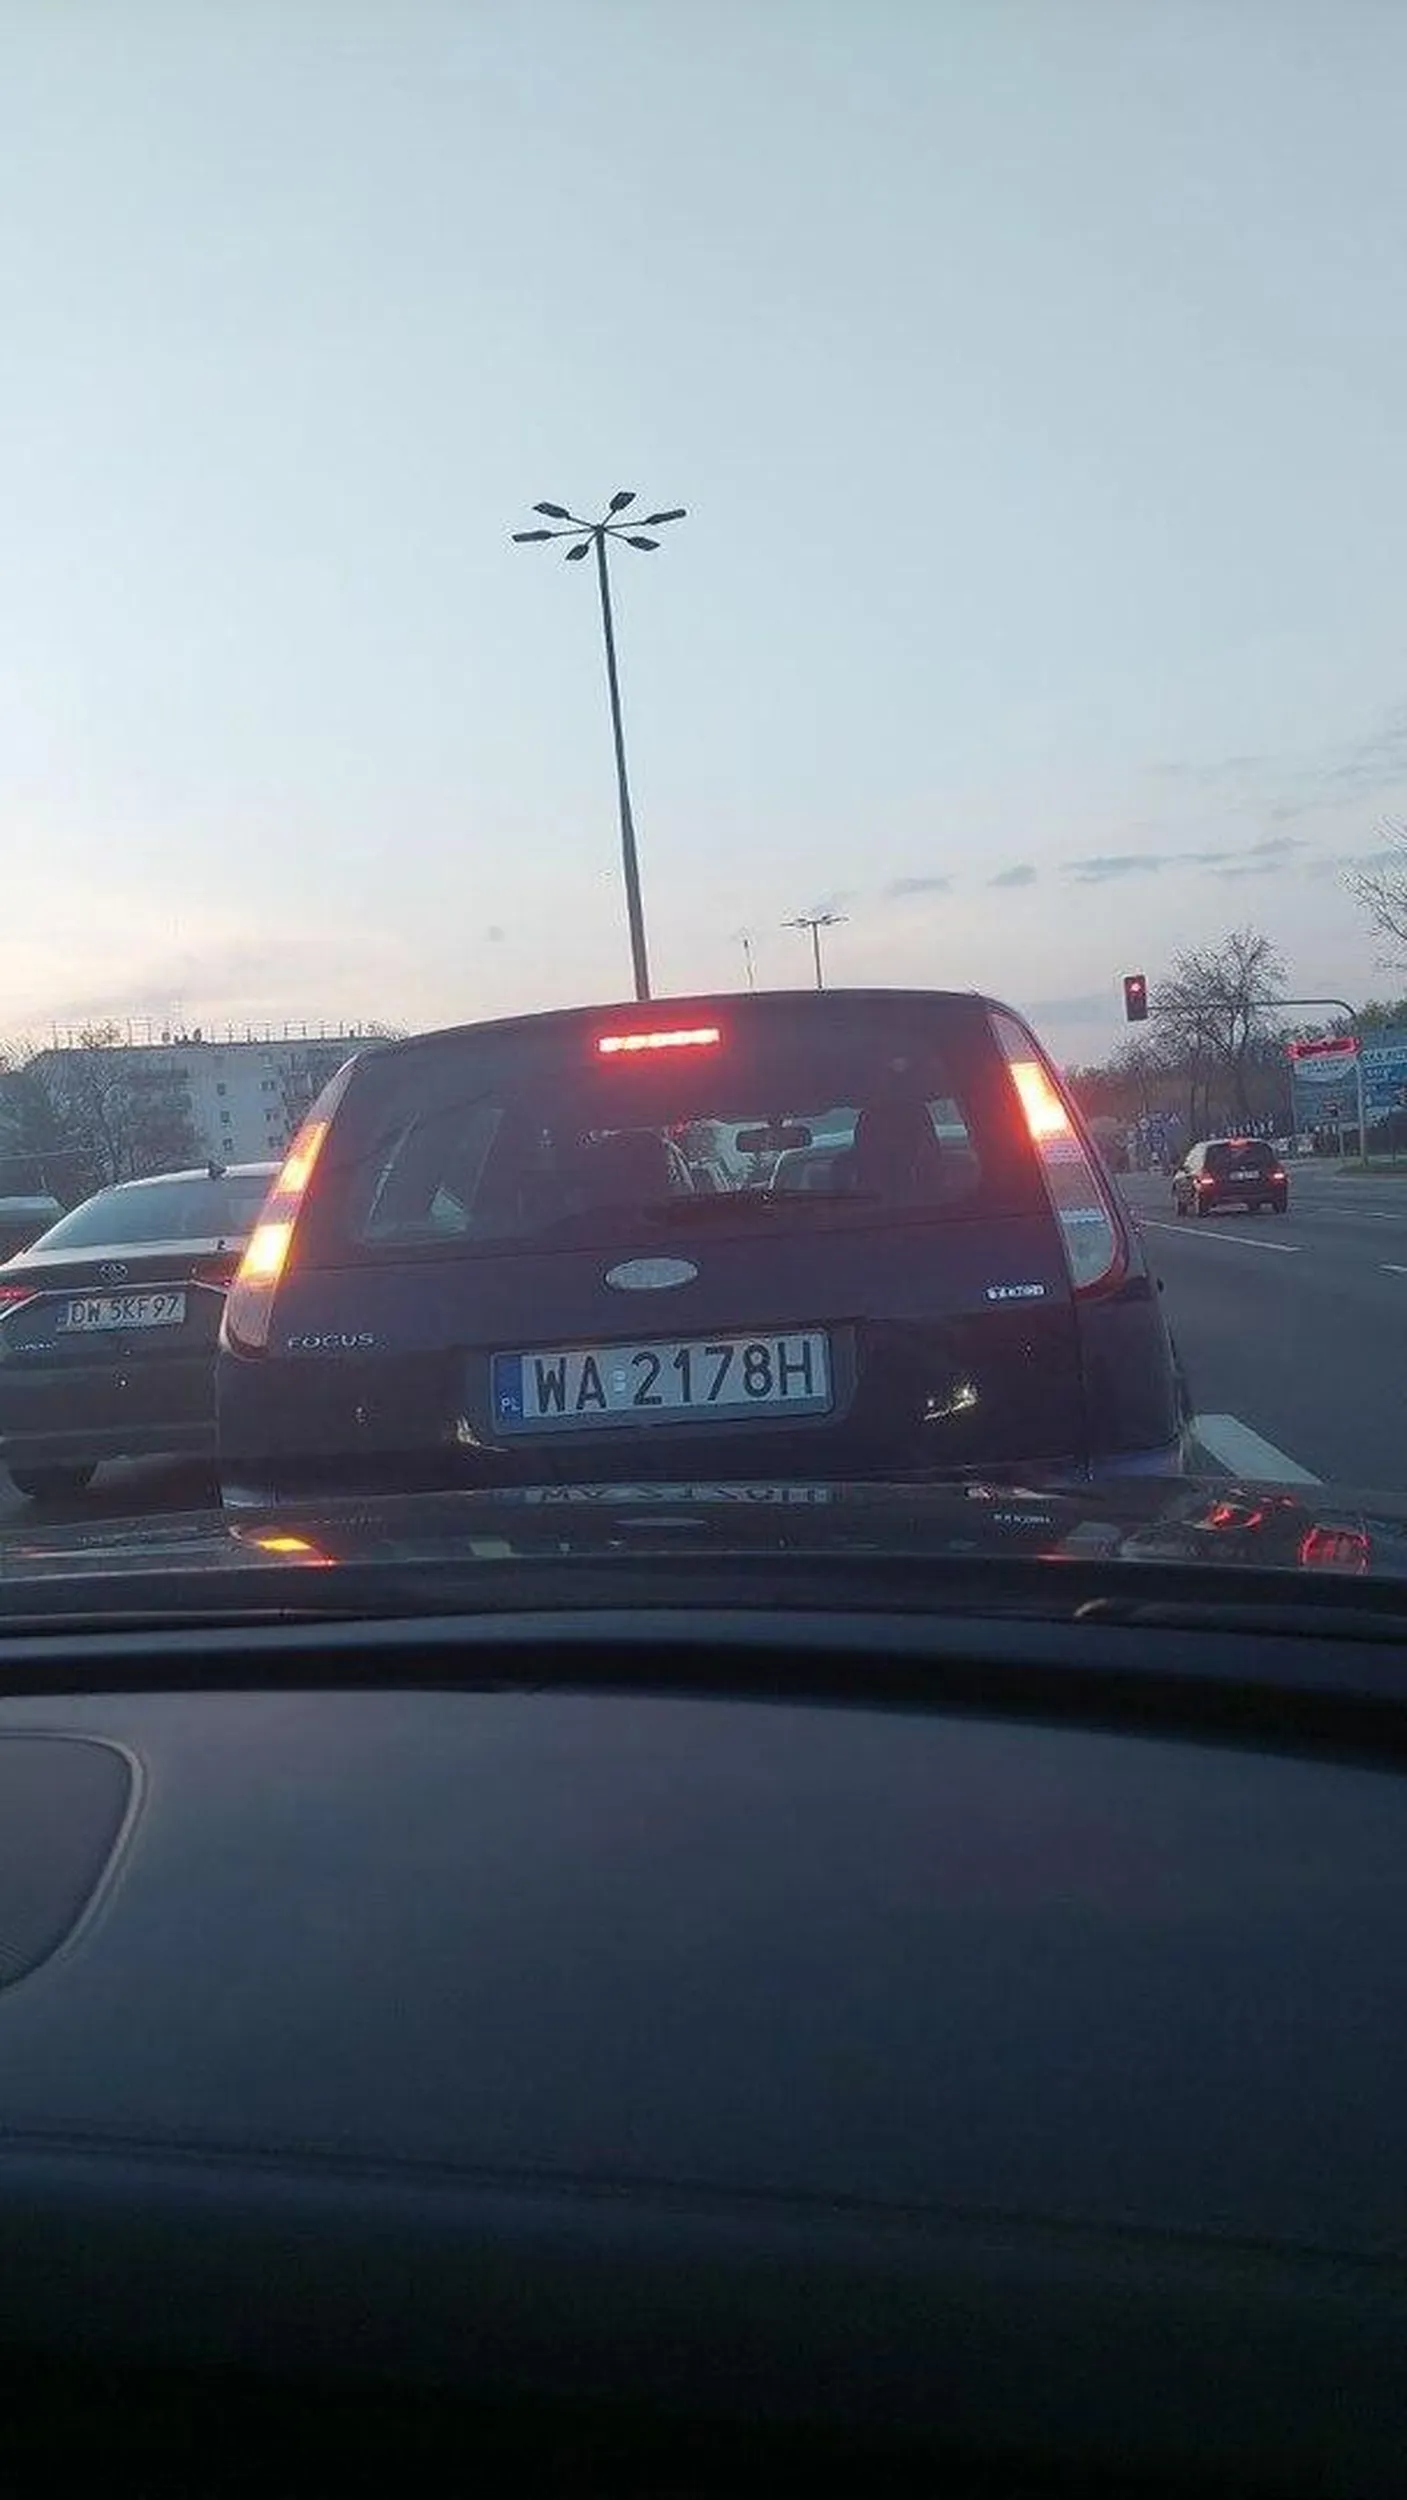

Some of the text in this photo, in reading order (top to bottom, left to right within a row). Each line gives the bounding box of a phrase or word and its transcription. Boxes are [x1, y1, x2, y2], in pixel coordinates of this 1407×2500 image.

[287, 1333, 373, 1350] FOCUS
[534, 1341, 813, 1413] WA 2178H
[501, 1397, 520, 1413] PL
